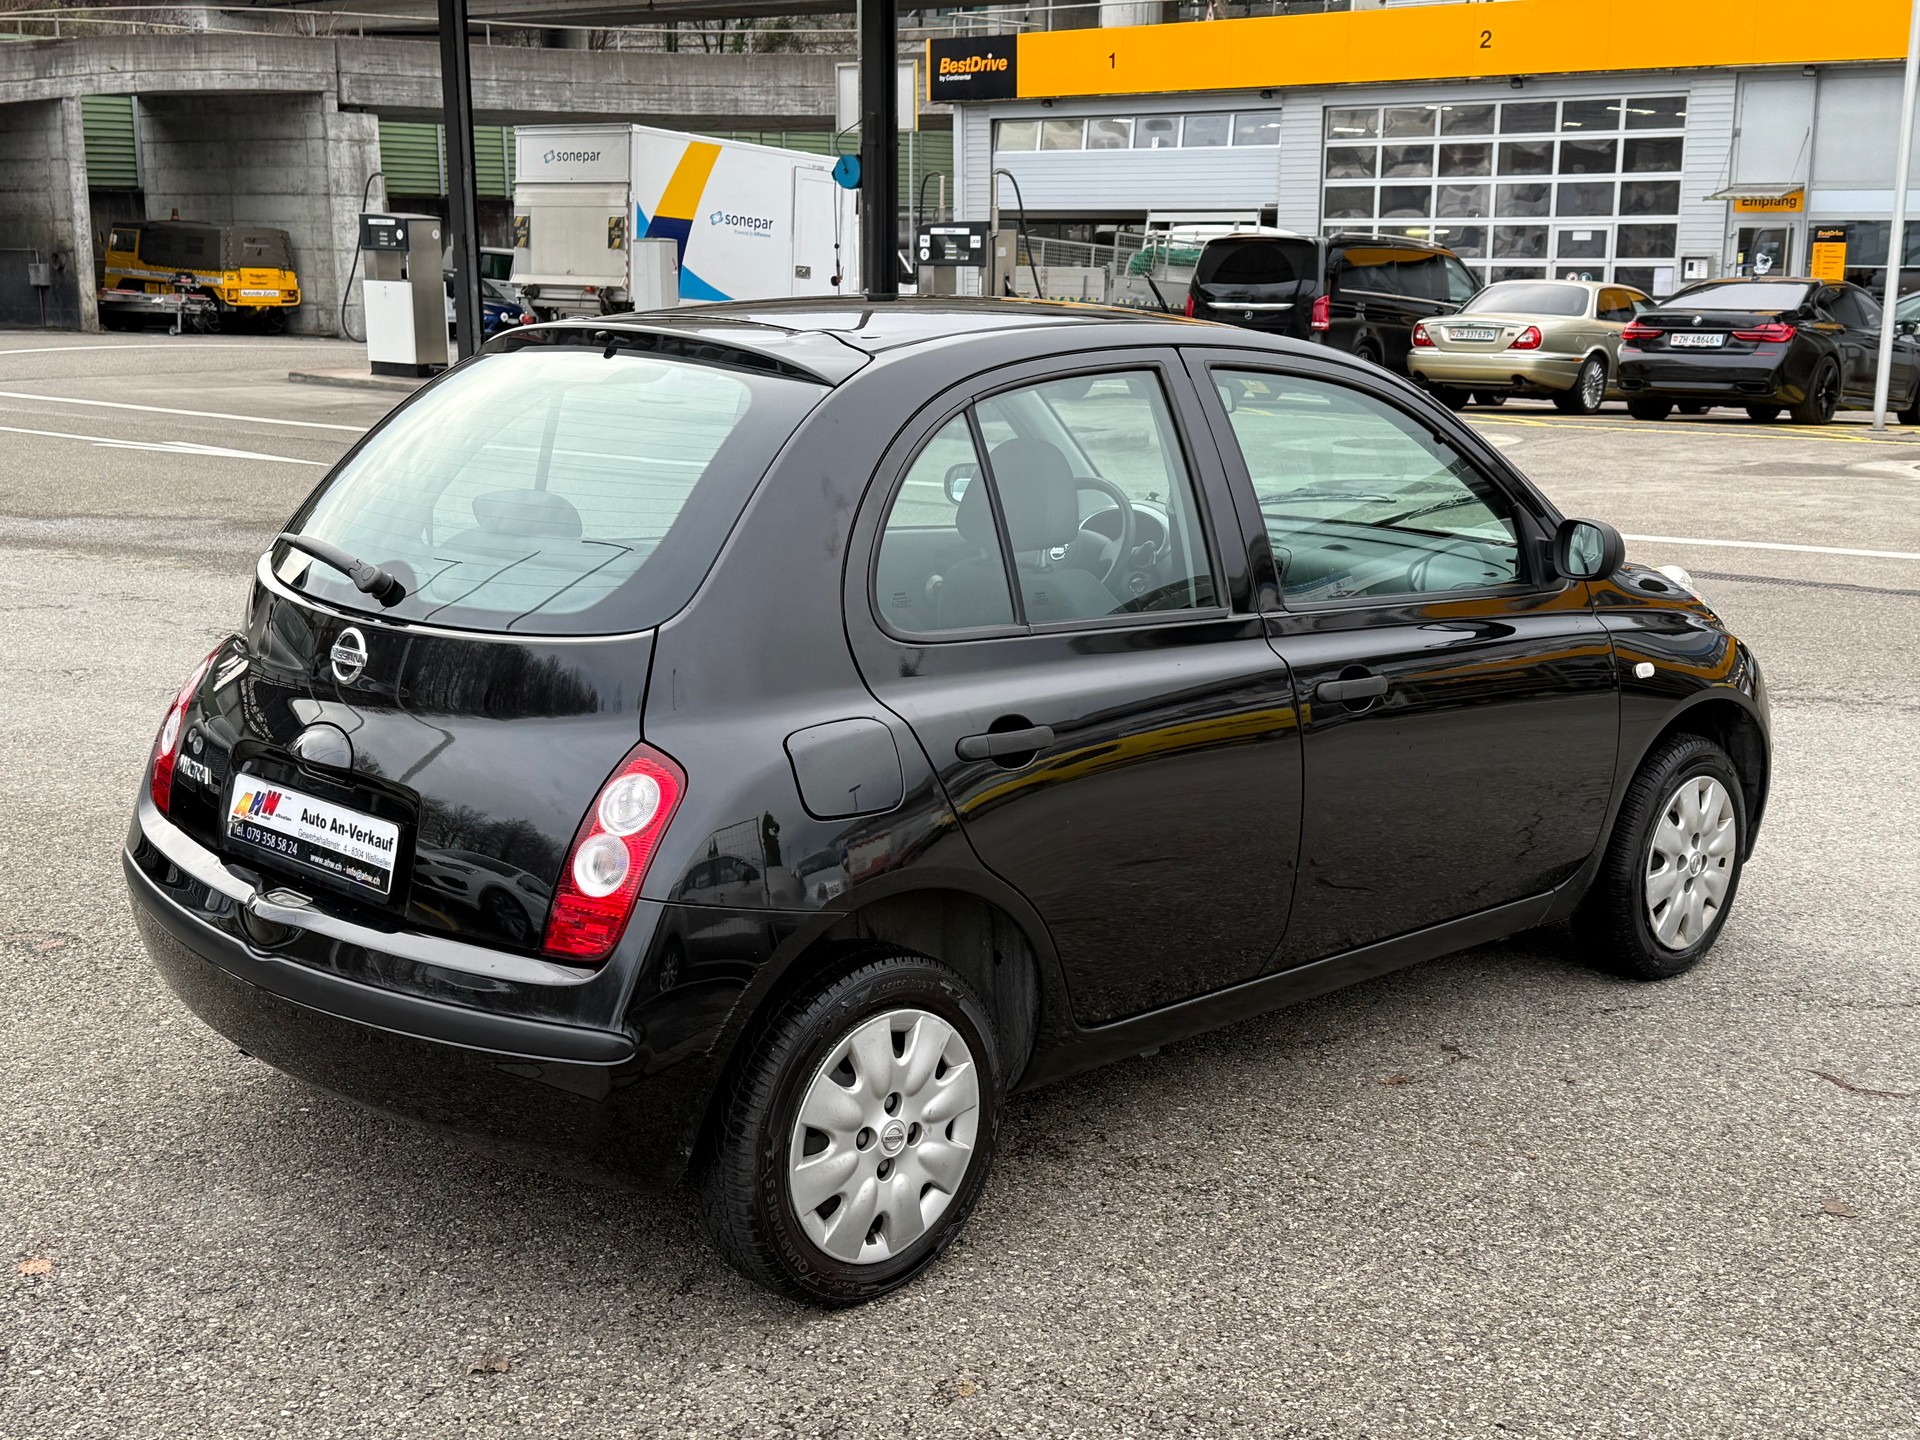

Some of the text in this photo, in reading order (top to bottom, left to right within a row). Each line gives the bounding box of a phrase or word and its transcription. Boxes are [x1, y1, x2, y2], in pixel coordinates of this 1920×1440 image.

[1479, 30, 1493, 49] 2
[939, 52, 1008, 74] BestDrive
[1108, 51, 1116, 69] 1
[556, 151, 601, 164] sonepar
[724, 214, 774, 231] sonepar
[232, 822, 299, 856] Tel. 079 358 58 24
[300, 808, 394, 852] Auto An-Verkauf
[310, 854, 343, 872] www.ahw.ch
